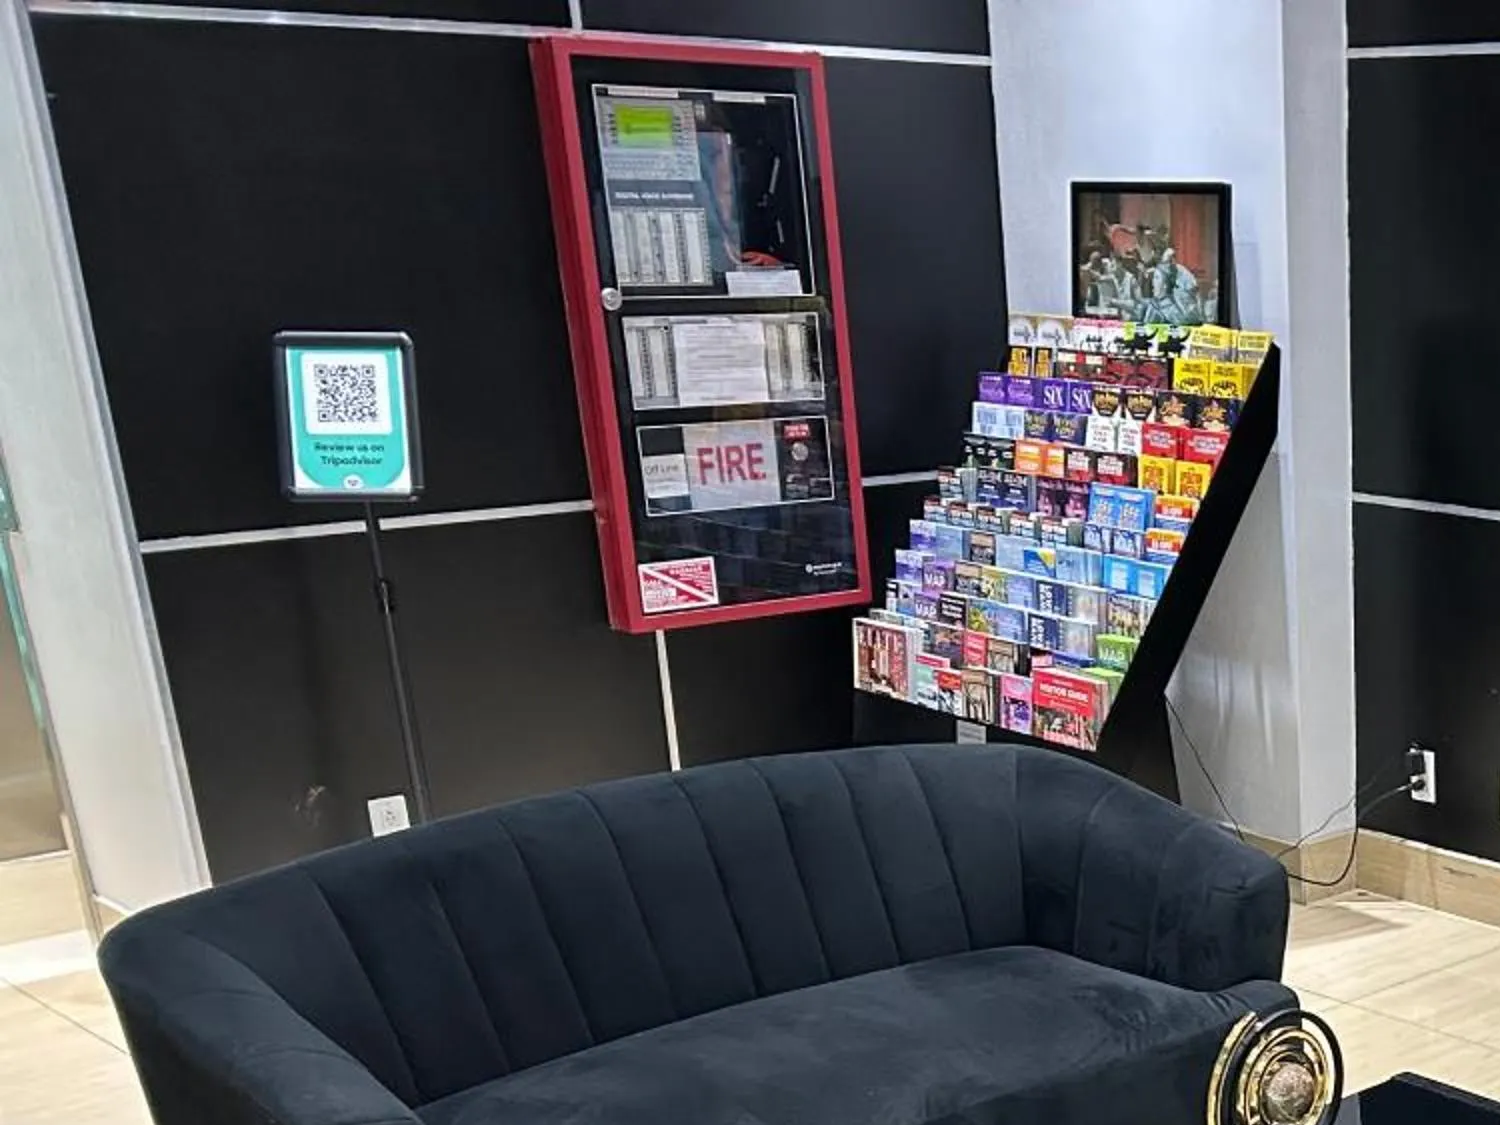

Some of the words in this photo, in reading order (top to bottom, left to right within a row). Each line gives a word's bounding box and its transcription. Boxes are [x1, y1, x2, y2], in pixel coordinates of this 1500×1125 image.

[314, 442, 355, 452] Review
[357, 444, 369, 452] us
[320, 455, 383, 466] Tripadvisor
[697, 443, 767, 485] FIRE
